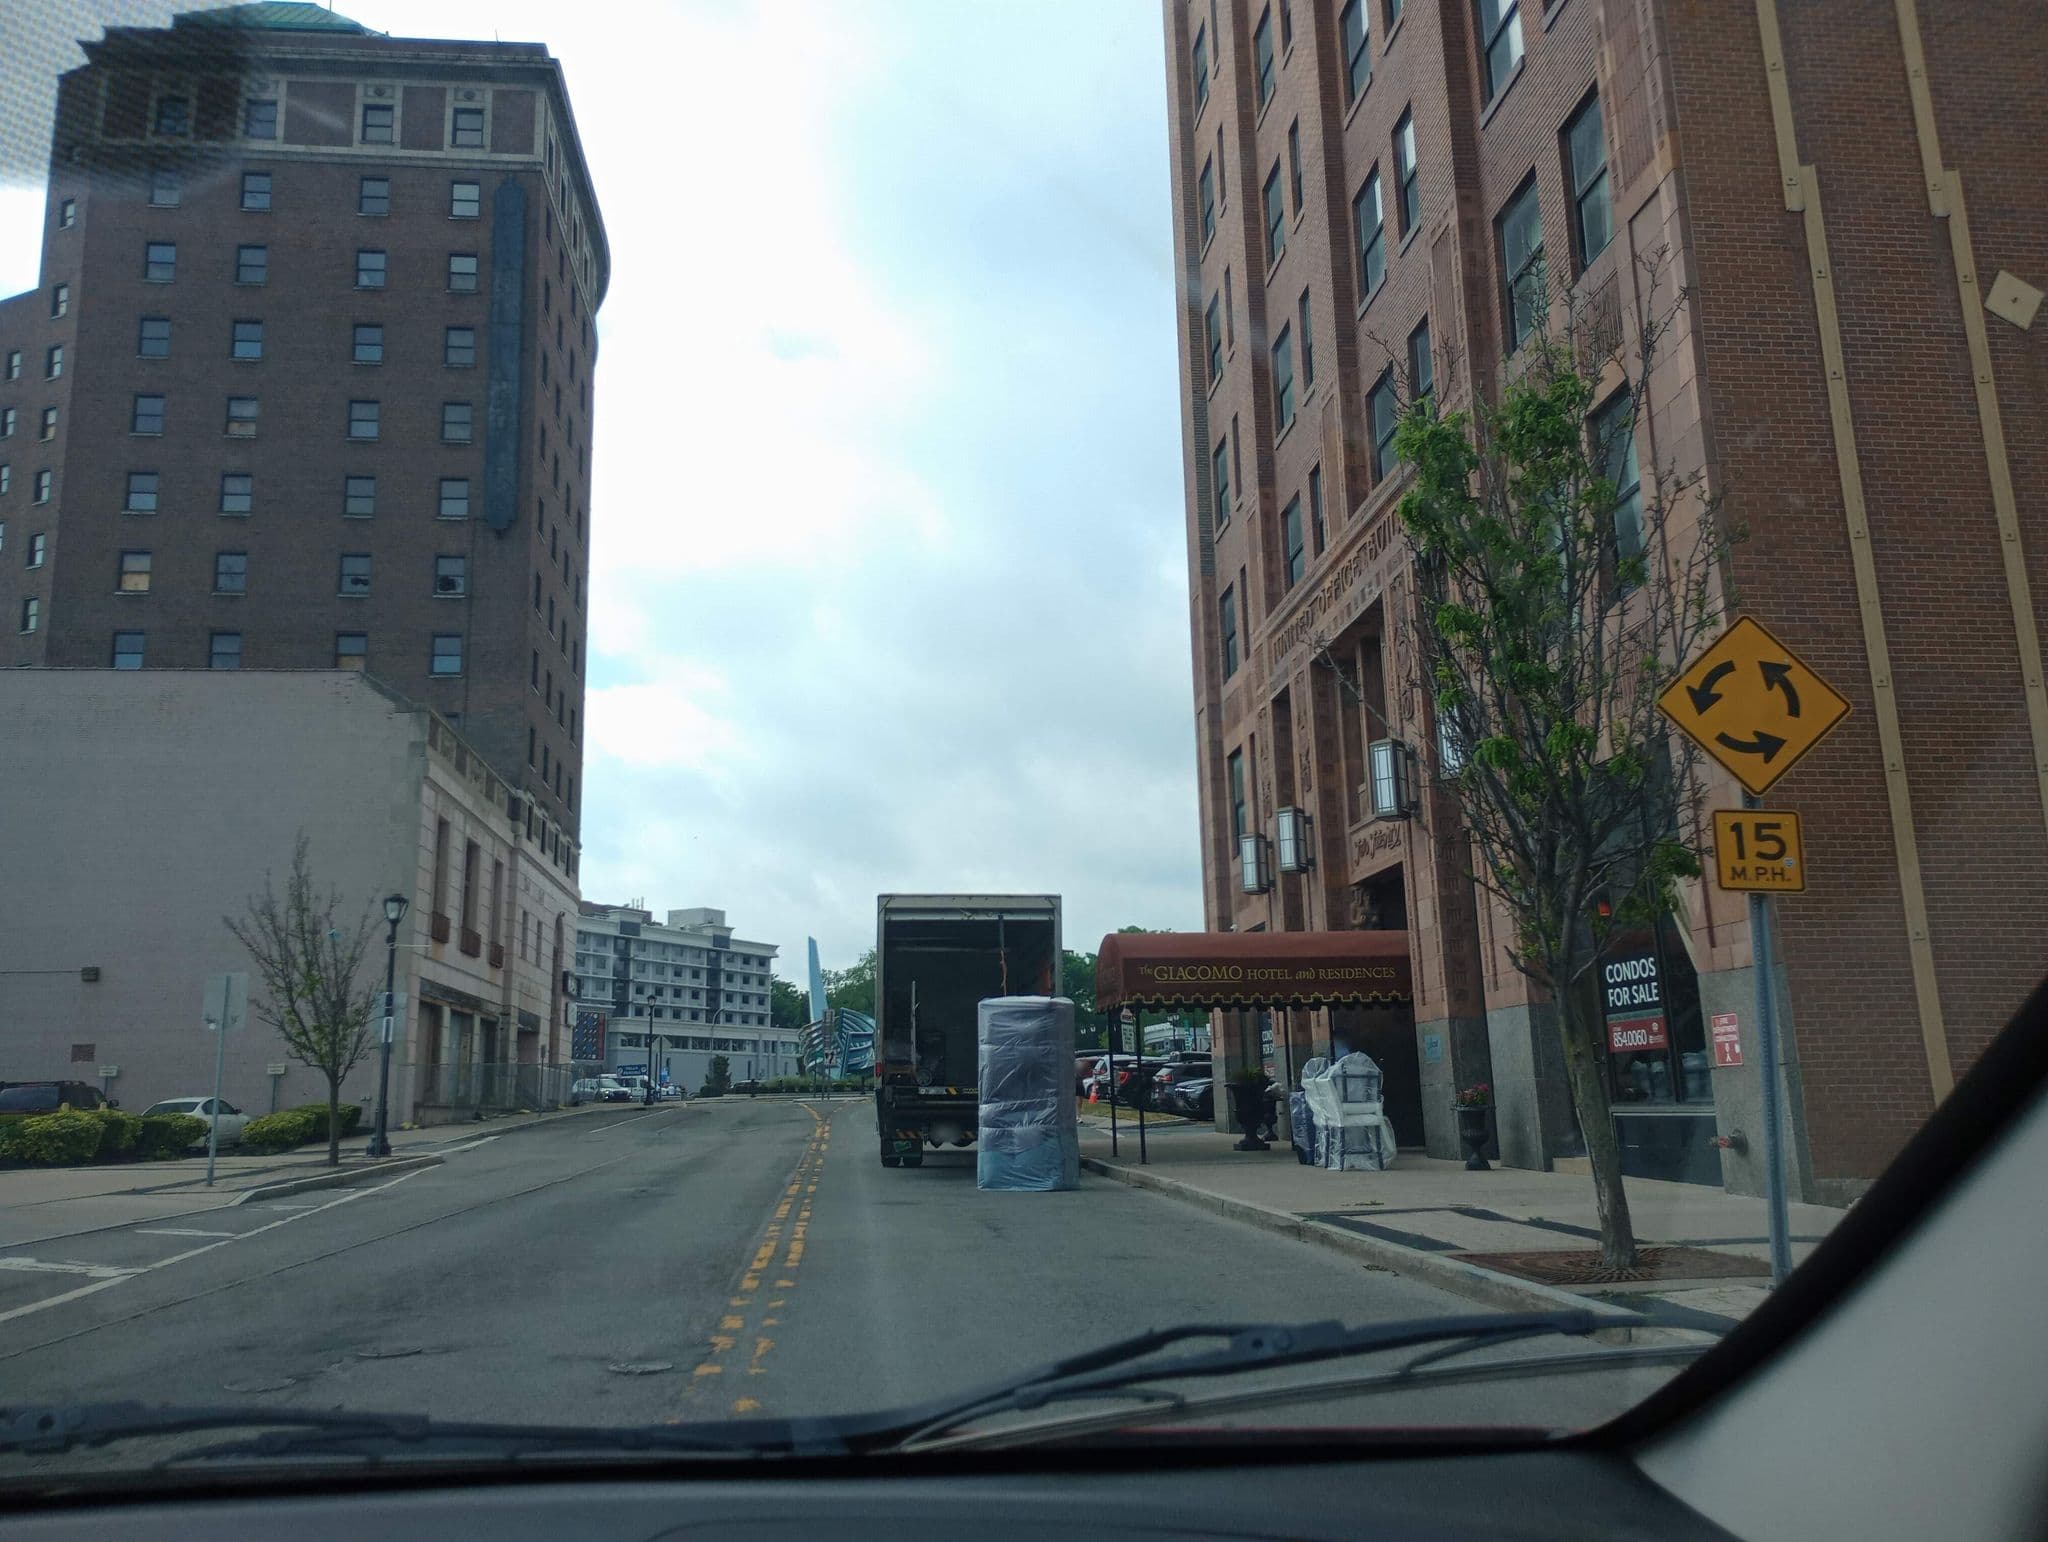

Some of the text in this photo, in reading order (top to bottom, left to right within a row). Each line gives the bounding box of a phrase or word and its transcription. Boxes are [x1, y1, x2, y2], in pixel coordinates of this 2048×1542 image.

[1319, 554, 1363, 614] OFFICE
[1368, 509, 1402, 560] BUIL
[1730, 822, 1787, 861] 15
[1154, 965, 1242, 981] GIACOMO
[1247, 968, 1292, 981] HOTEL
[1295, 967, 1315, 980] and
[1319, 966, 1395, 981] RESIDENCES
[1605, 957, 1656, 983] CONDOS
[1608, 982, 1659, 1007] FOR SALE
